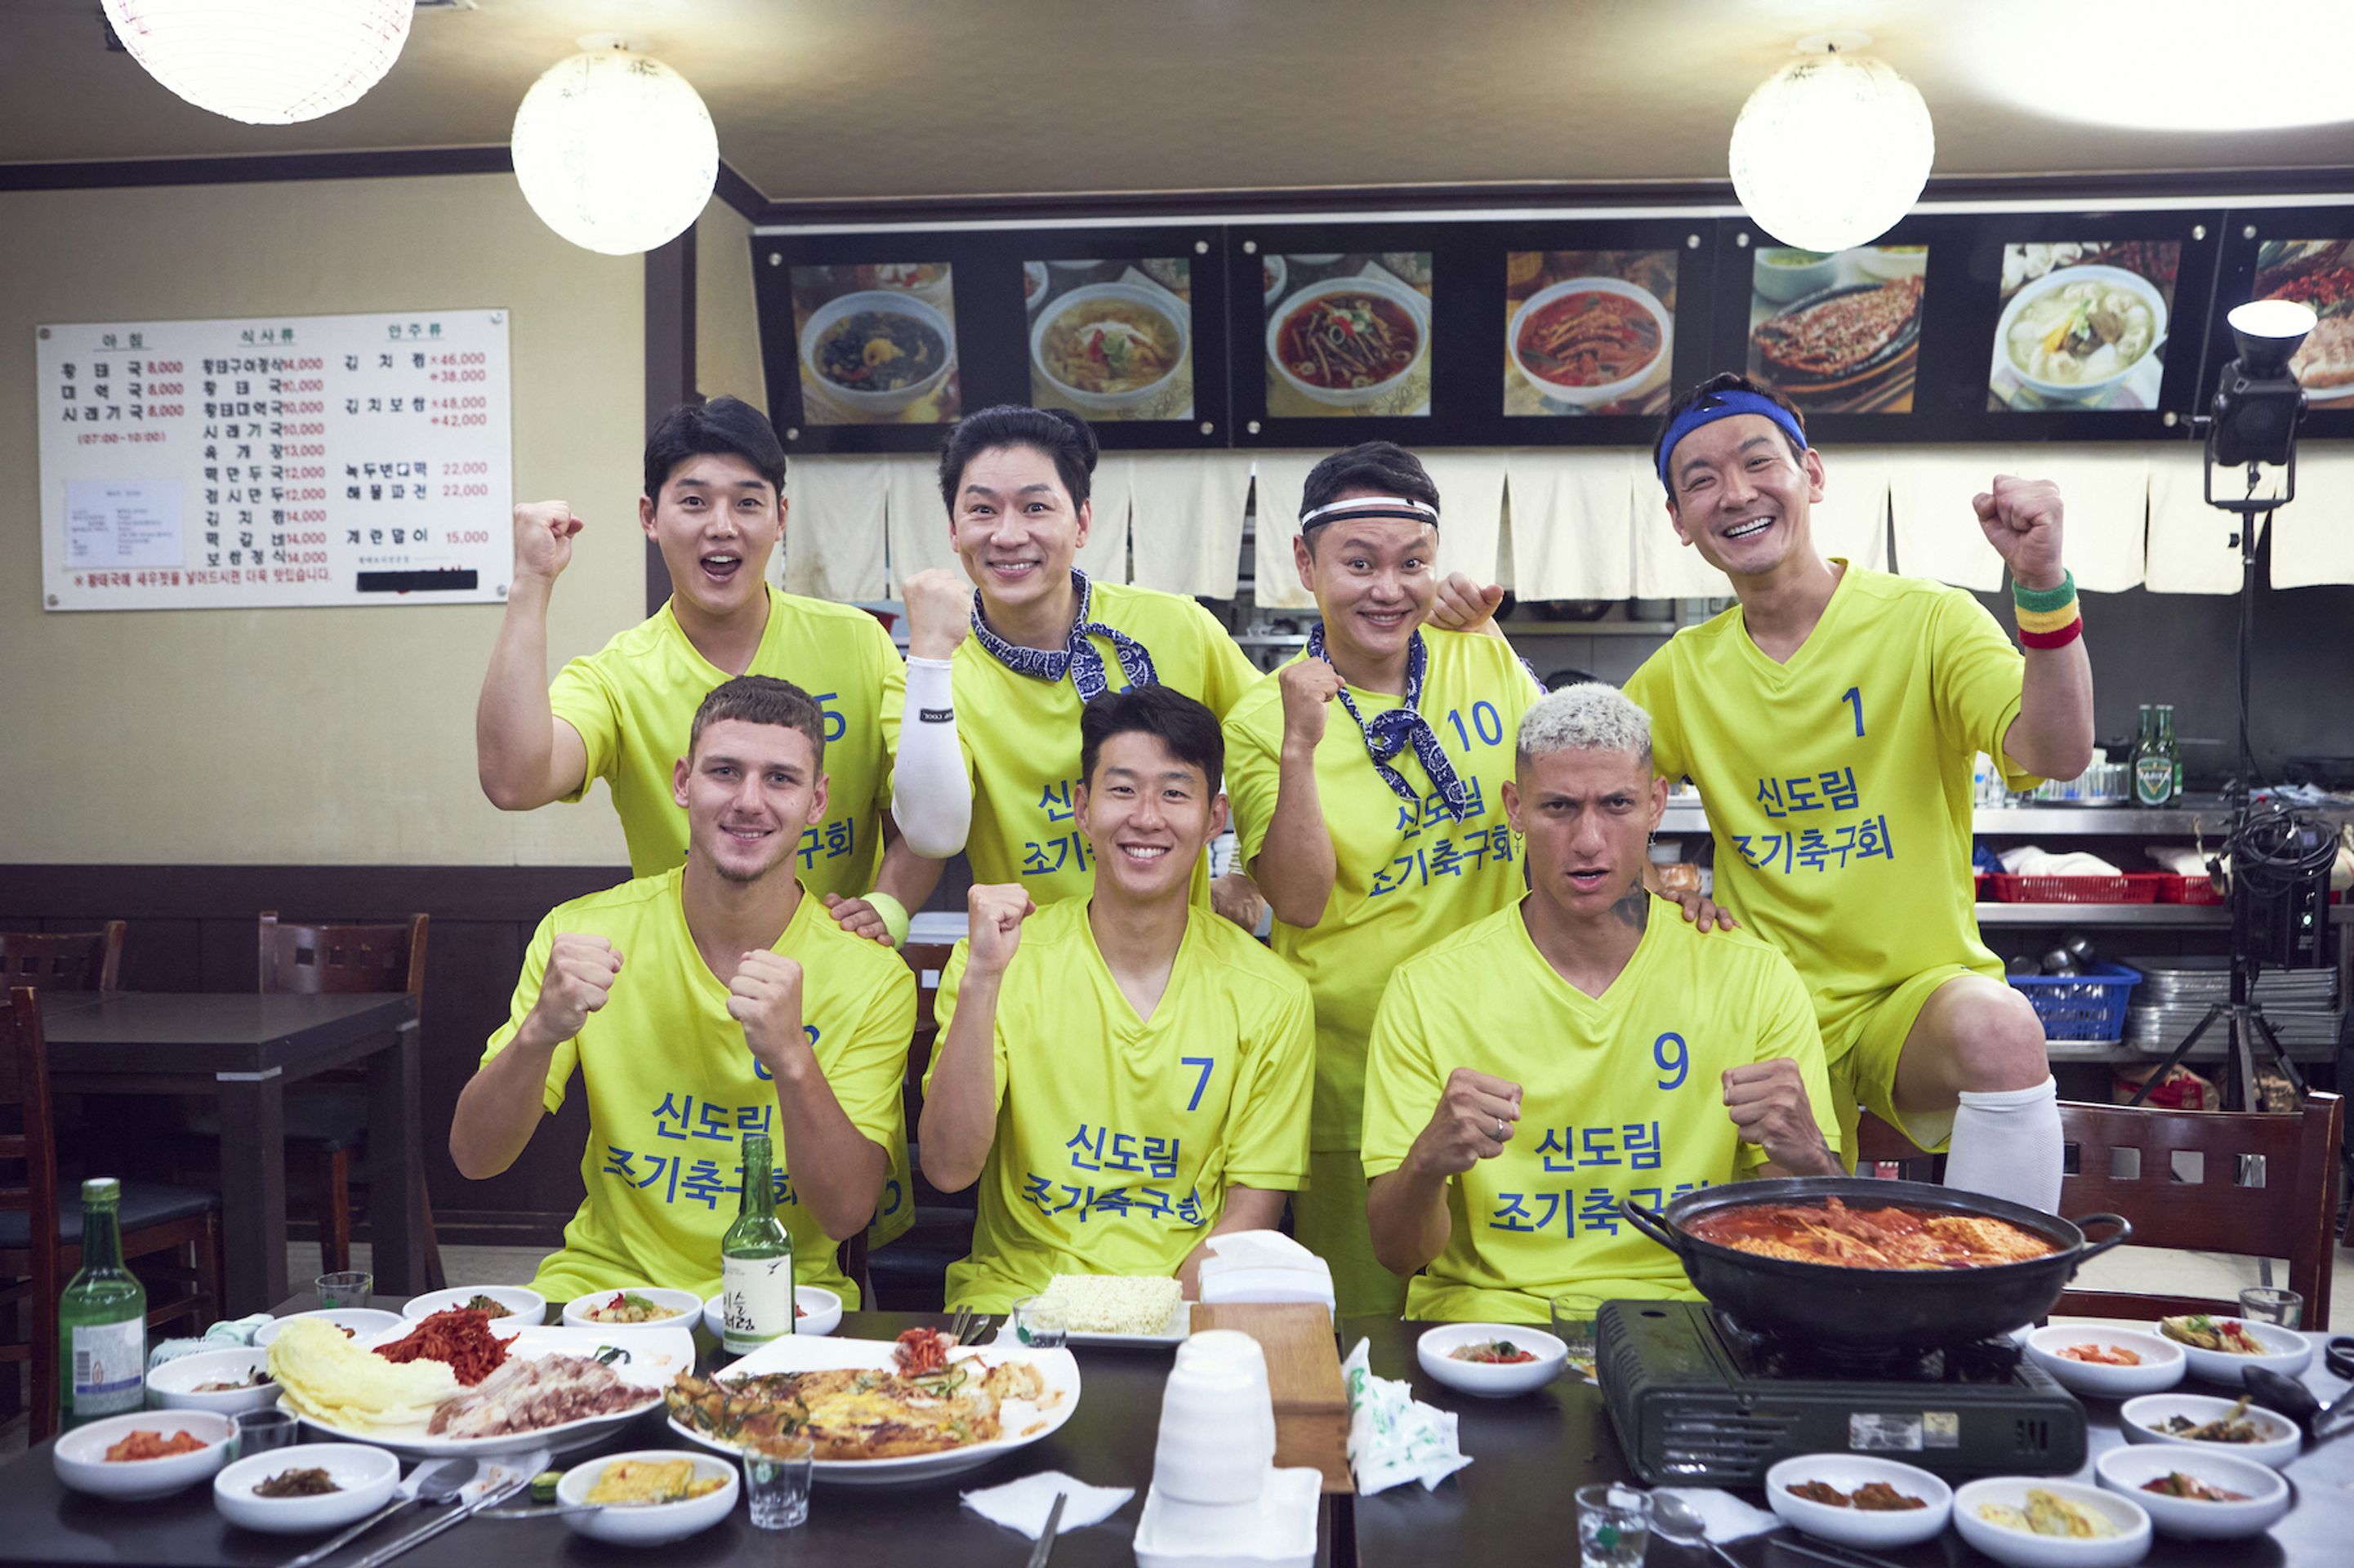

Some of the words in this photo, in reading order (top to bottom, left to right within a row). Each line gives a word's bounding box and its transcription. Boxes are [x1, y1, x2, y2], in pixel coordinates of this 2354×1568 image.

[443, 461, 488, 475] 22,000
[443, 484, 488, 497] 22,000
[446, 531, 488, 544] 15,000
[1447, 700, 1503, 753] 10
[1841, 686, 1865, 737] 1
[1756, 766, 1859, 817] 신도림
[1368, 824, 1513, 898] 조기축구회
[1732, 814, 1894, 875] 조기축구회
[1181, 1057, 1214, 1111] 7
[1653, 1031, 1689, 1090] 9
[1065, 1124, 1179, 1178] 신도림
[1535, 1121, 1661, 1173] 신도림
[1022, 1173, 1207, 1226] 조기축구회
[1489, 1180, 1709, 1239] 조기축구
